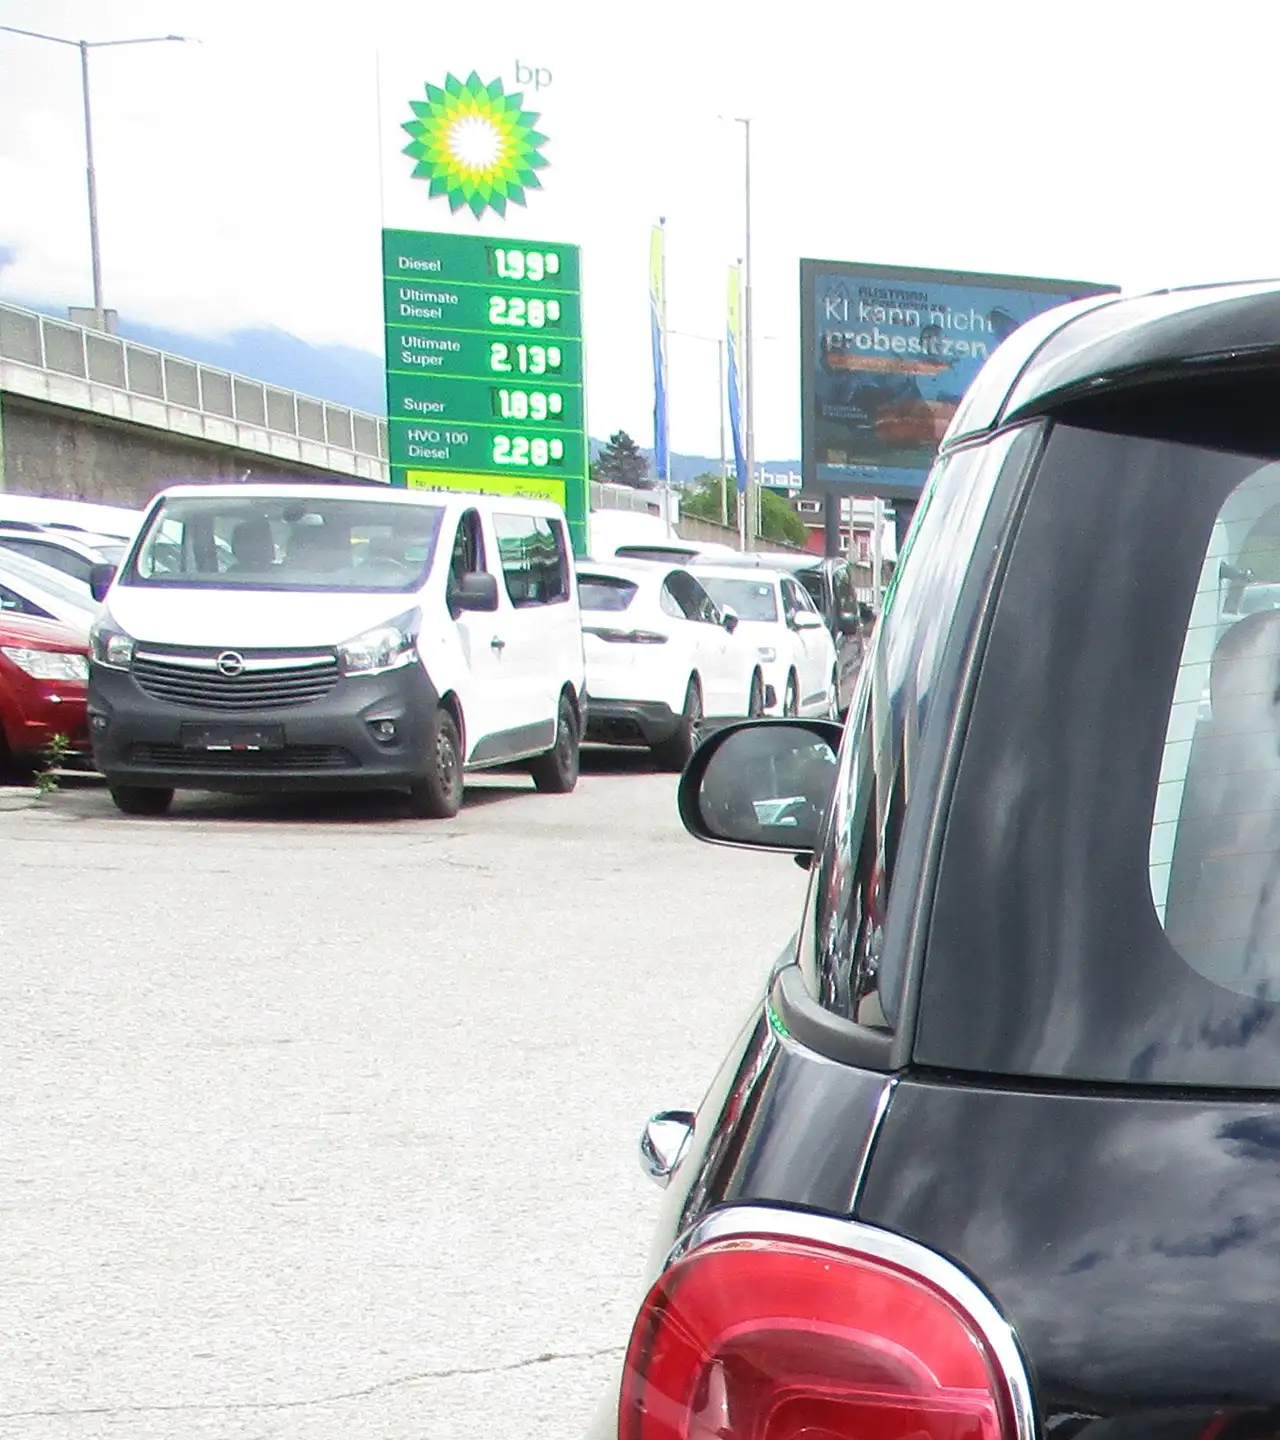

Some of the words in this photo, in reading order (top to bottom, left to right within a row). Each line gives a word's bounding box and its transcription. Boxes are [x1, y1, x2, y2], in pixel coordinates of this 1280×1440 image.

[515, 59, 552, 92] bp
[399, 256, 441, 272] Diesel
[400, 288, 459, 304] Ultimate
[401, 304, 442, 319] Diesel
[825, 297, 848, 322] KI
[859, 300, 920, 327] kann
[402, 335, 460, 352] Ultimate
[826, 327, 987, 359] probesitzen
[402, 351, 444, 368] Super
[403, 398, 445, 415] Super
[408, 429, 440, 443] HVO
[445, 431, 469, 445] 100
[408, 444, 450, 460] Diesel
